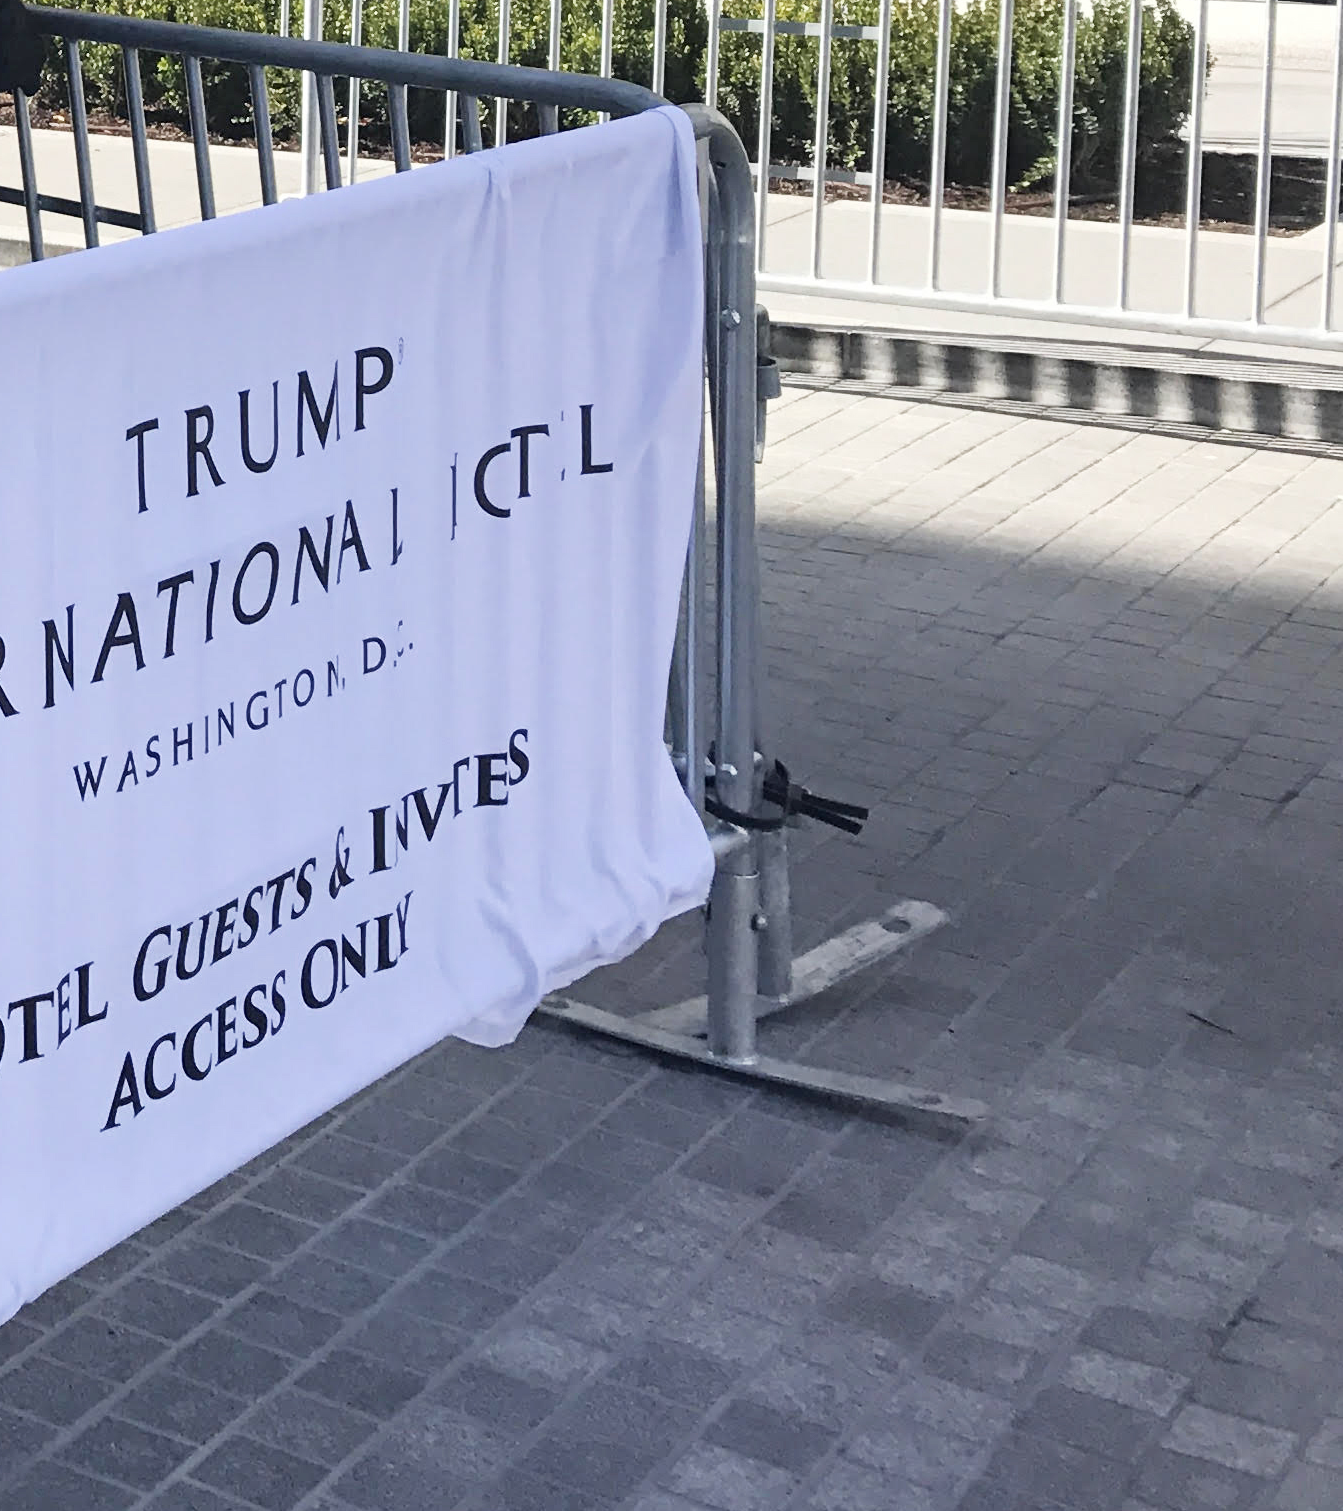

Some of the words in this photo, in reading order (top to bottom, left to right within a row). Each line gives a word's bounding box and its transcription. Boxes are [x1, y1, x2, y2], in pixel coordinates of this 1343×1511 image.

[125, 346, 394, 514] TRUMP
[132, 857, 317, 1002] GUESTS
[328, 826, 355, 900] &
[100, 969, 287, 1132] ACCESS
[300, 890, 414, 1010] ONLY
